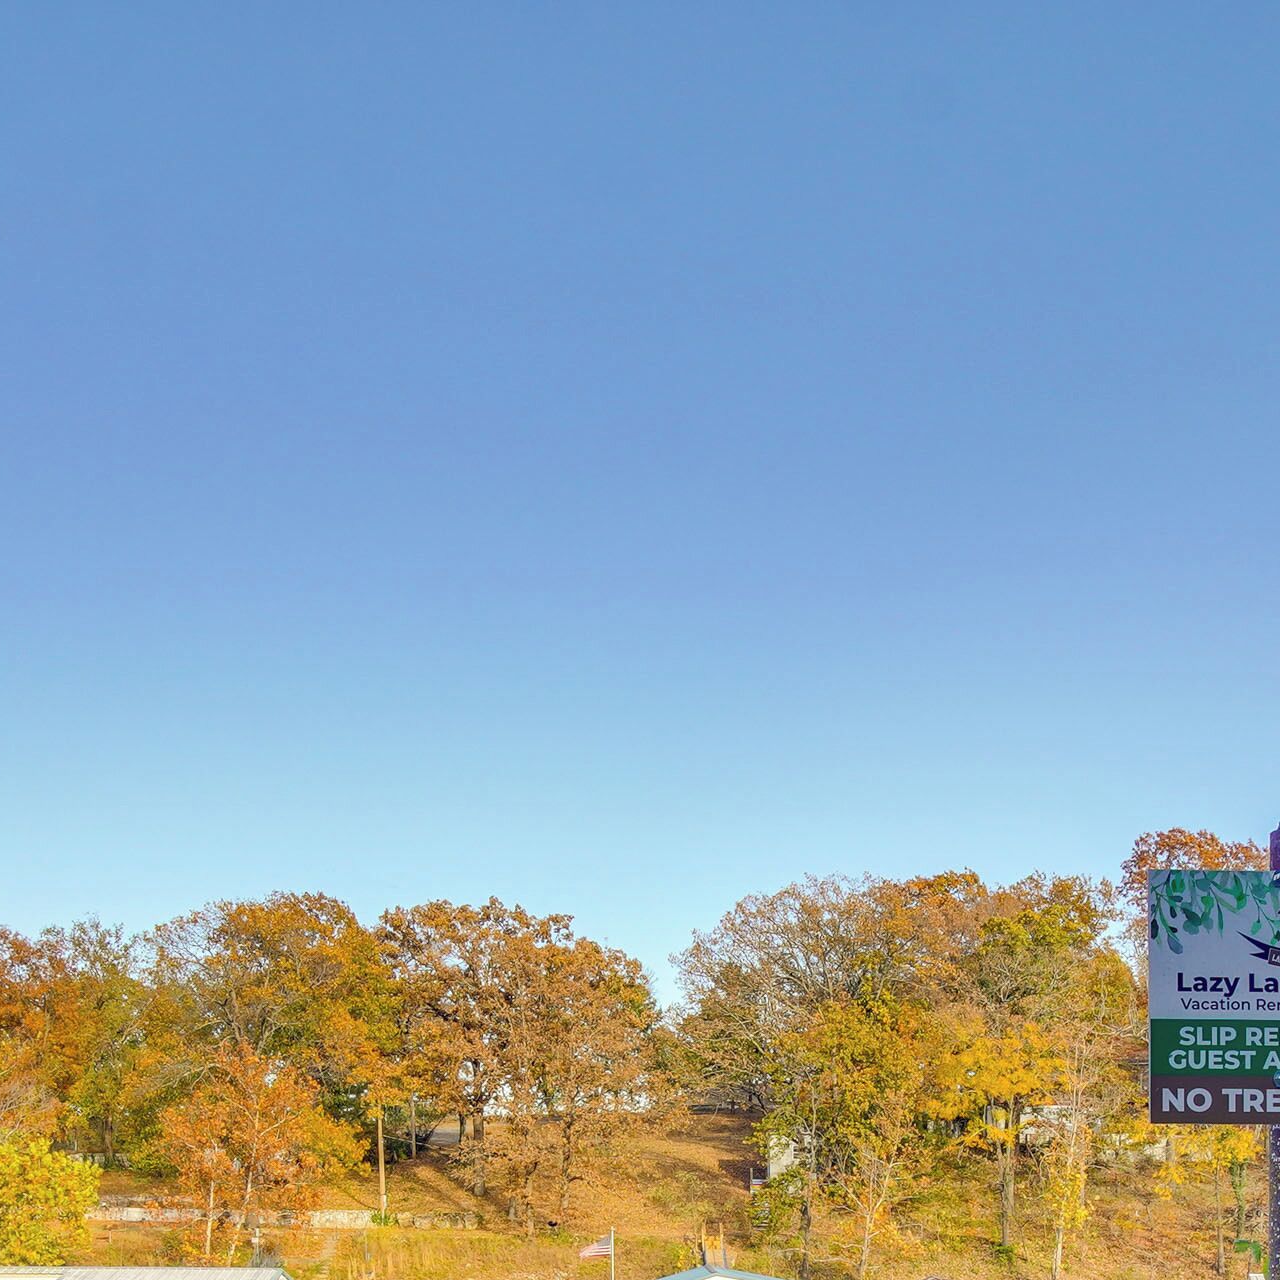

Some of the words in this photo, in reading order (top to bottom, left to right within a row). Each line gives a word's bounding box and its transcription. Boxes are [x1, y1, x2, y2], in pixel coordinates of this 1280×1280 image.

[1177, 972, 1240, 997] Lazy
[1180, 997, 1251, 1012] Vacation
[1179, 1026, 1237, 1047] SLIP
[1168, 1050, 1256, 1070] GUEST
[1161, 1087, 1213, 1113] NO
